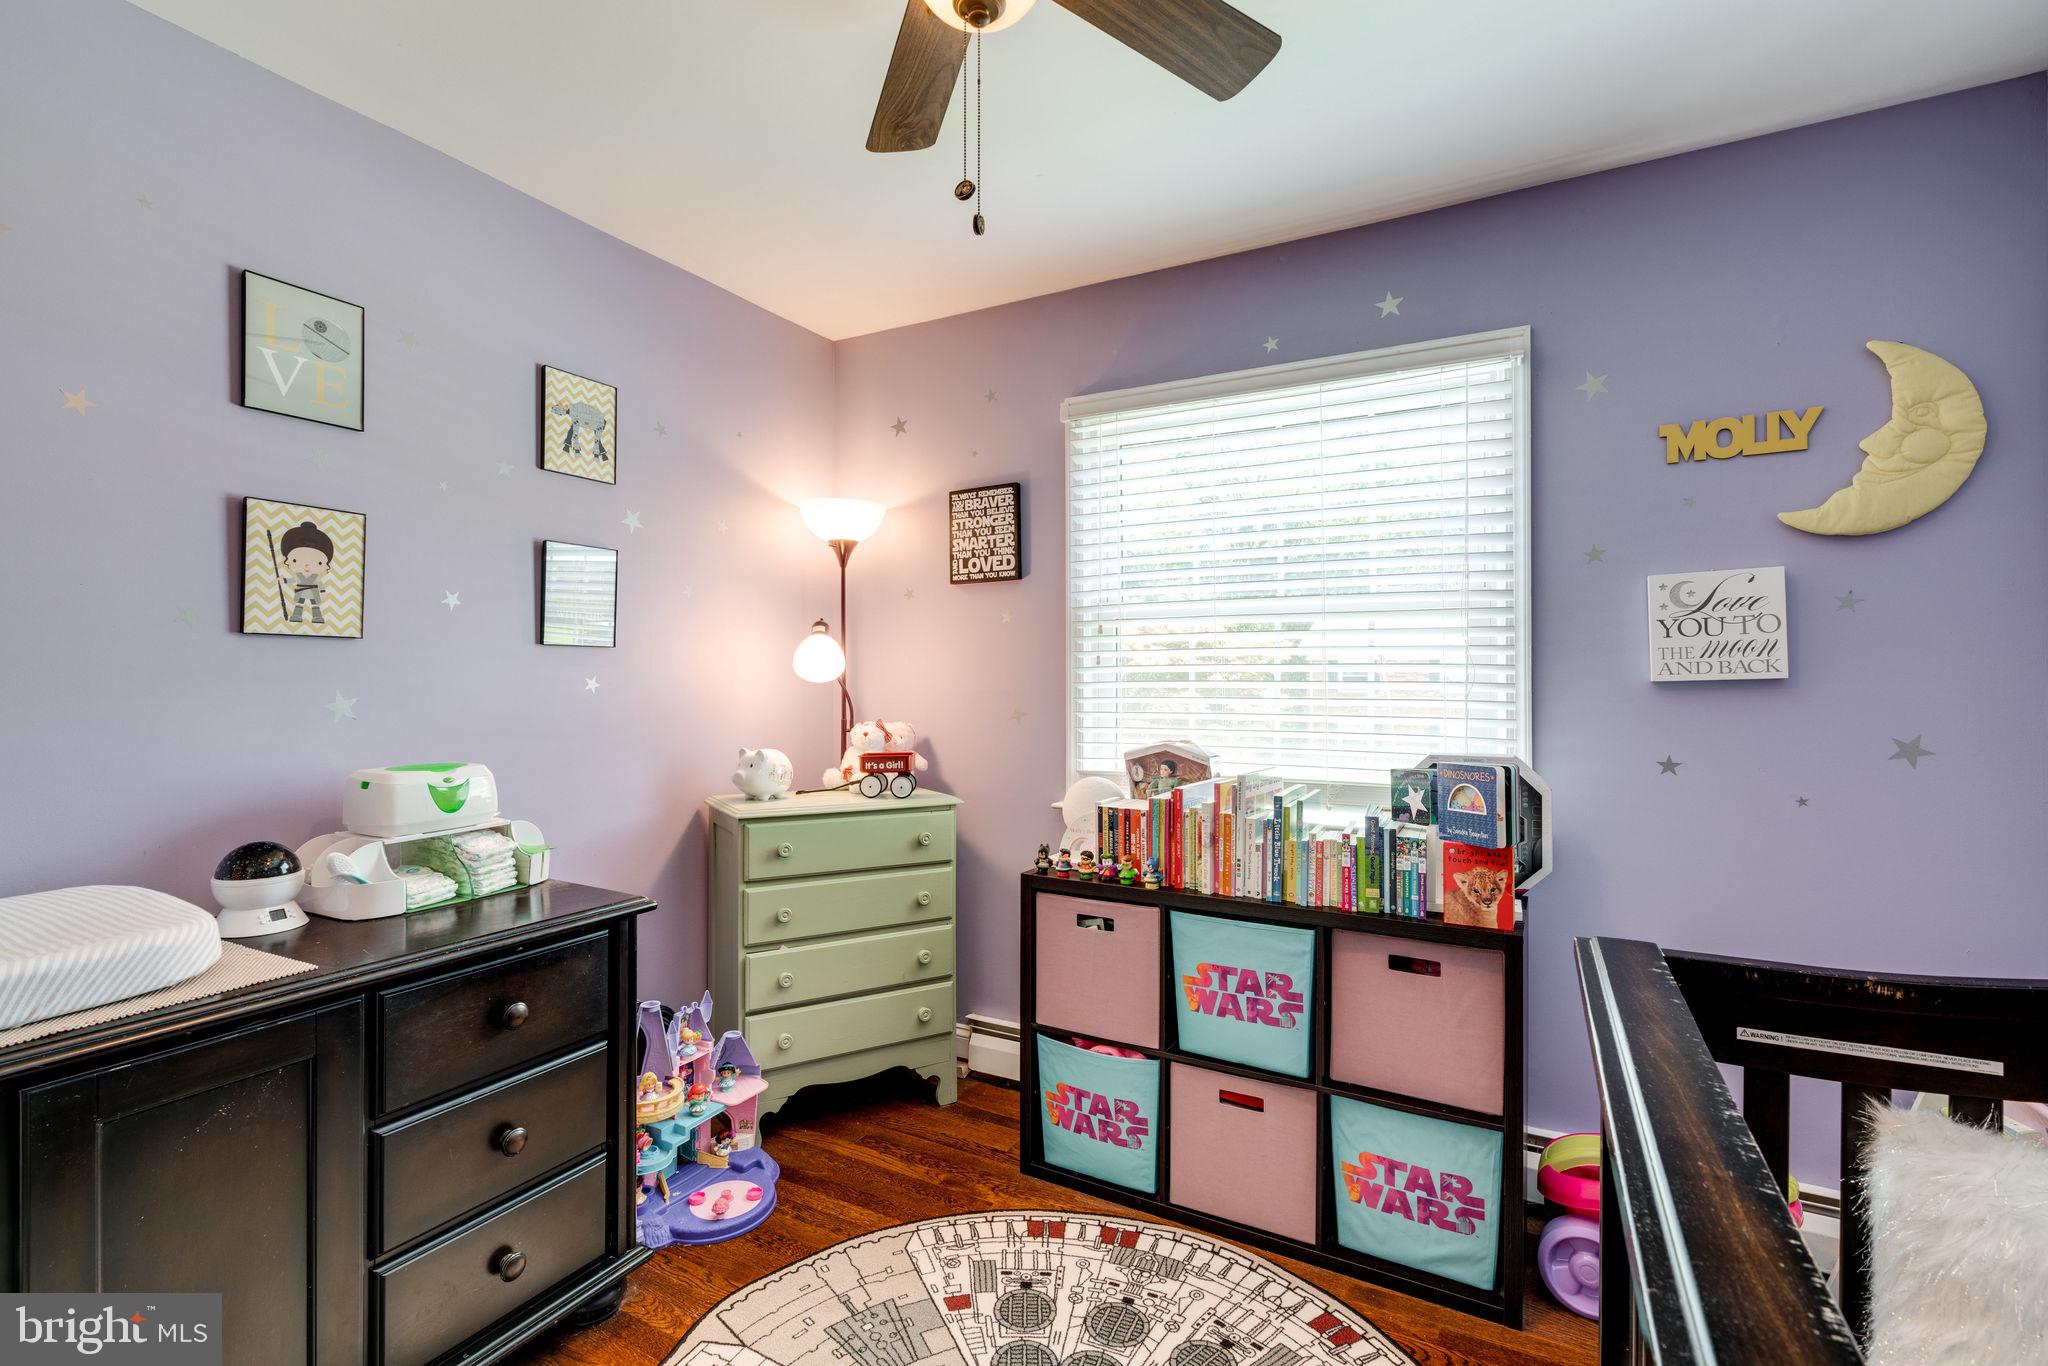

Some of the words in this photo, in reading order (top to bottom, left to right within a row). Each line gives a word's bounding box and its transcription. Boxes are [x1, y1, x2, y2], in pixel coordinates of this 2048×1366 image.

[1658, 405, 1824, 464] MOLLY
[952, 530, 972, 538] THAN
[975, 527, 992, 536] YOU
[952, 551, 972, 559] THAN
[974, 549, 990, 558] YOU
[959, 554, 1016, 574] LOVED
[1669, 573, 1769, 618] Love
[1656, 616, 1726, 638] YOU
[1733, 613, 1782, 635] TO
[1658, 646, 1695, 660] THE
[1698, 638, 1782, 659] moon
[1657, 661, 1713, 675] AND
[1717, 659, 1783, 675] BACK
[865, 762, 878, 770] It's
[886, 760, 904, 769] Girl!
[1443, 769, 1491, 782] DINOSNORES
[1447, 826, 1452, 835] by
[1452, 826, 1468, 836] Sandra
[1468, 829, 1488, 840] Boynton
[1458, 848, 1485, 857] bright
[1183, 962, 1303, 1003] STAR
[1184, 985, 1303, 1029] WARS
[1750, 1032, 1779, 1041] WARNING
[1045, 1082, 1148, 1126] STAR
[1046, 1100, 1148, 1150] WARS
[1342, 1152, 1485, 1210] STAR
[1344, 1174, 1485, 1235] WARS
